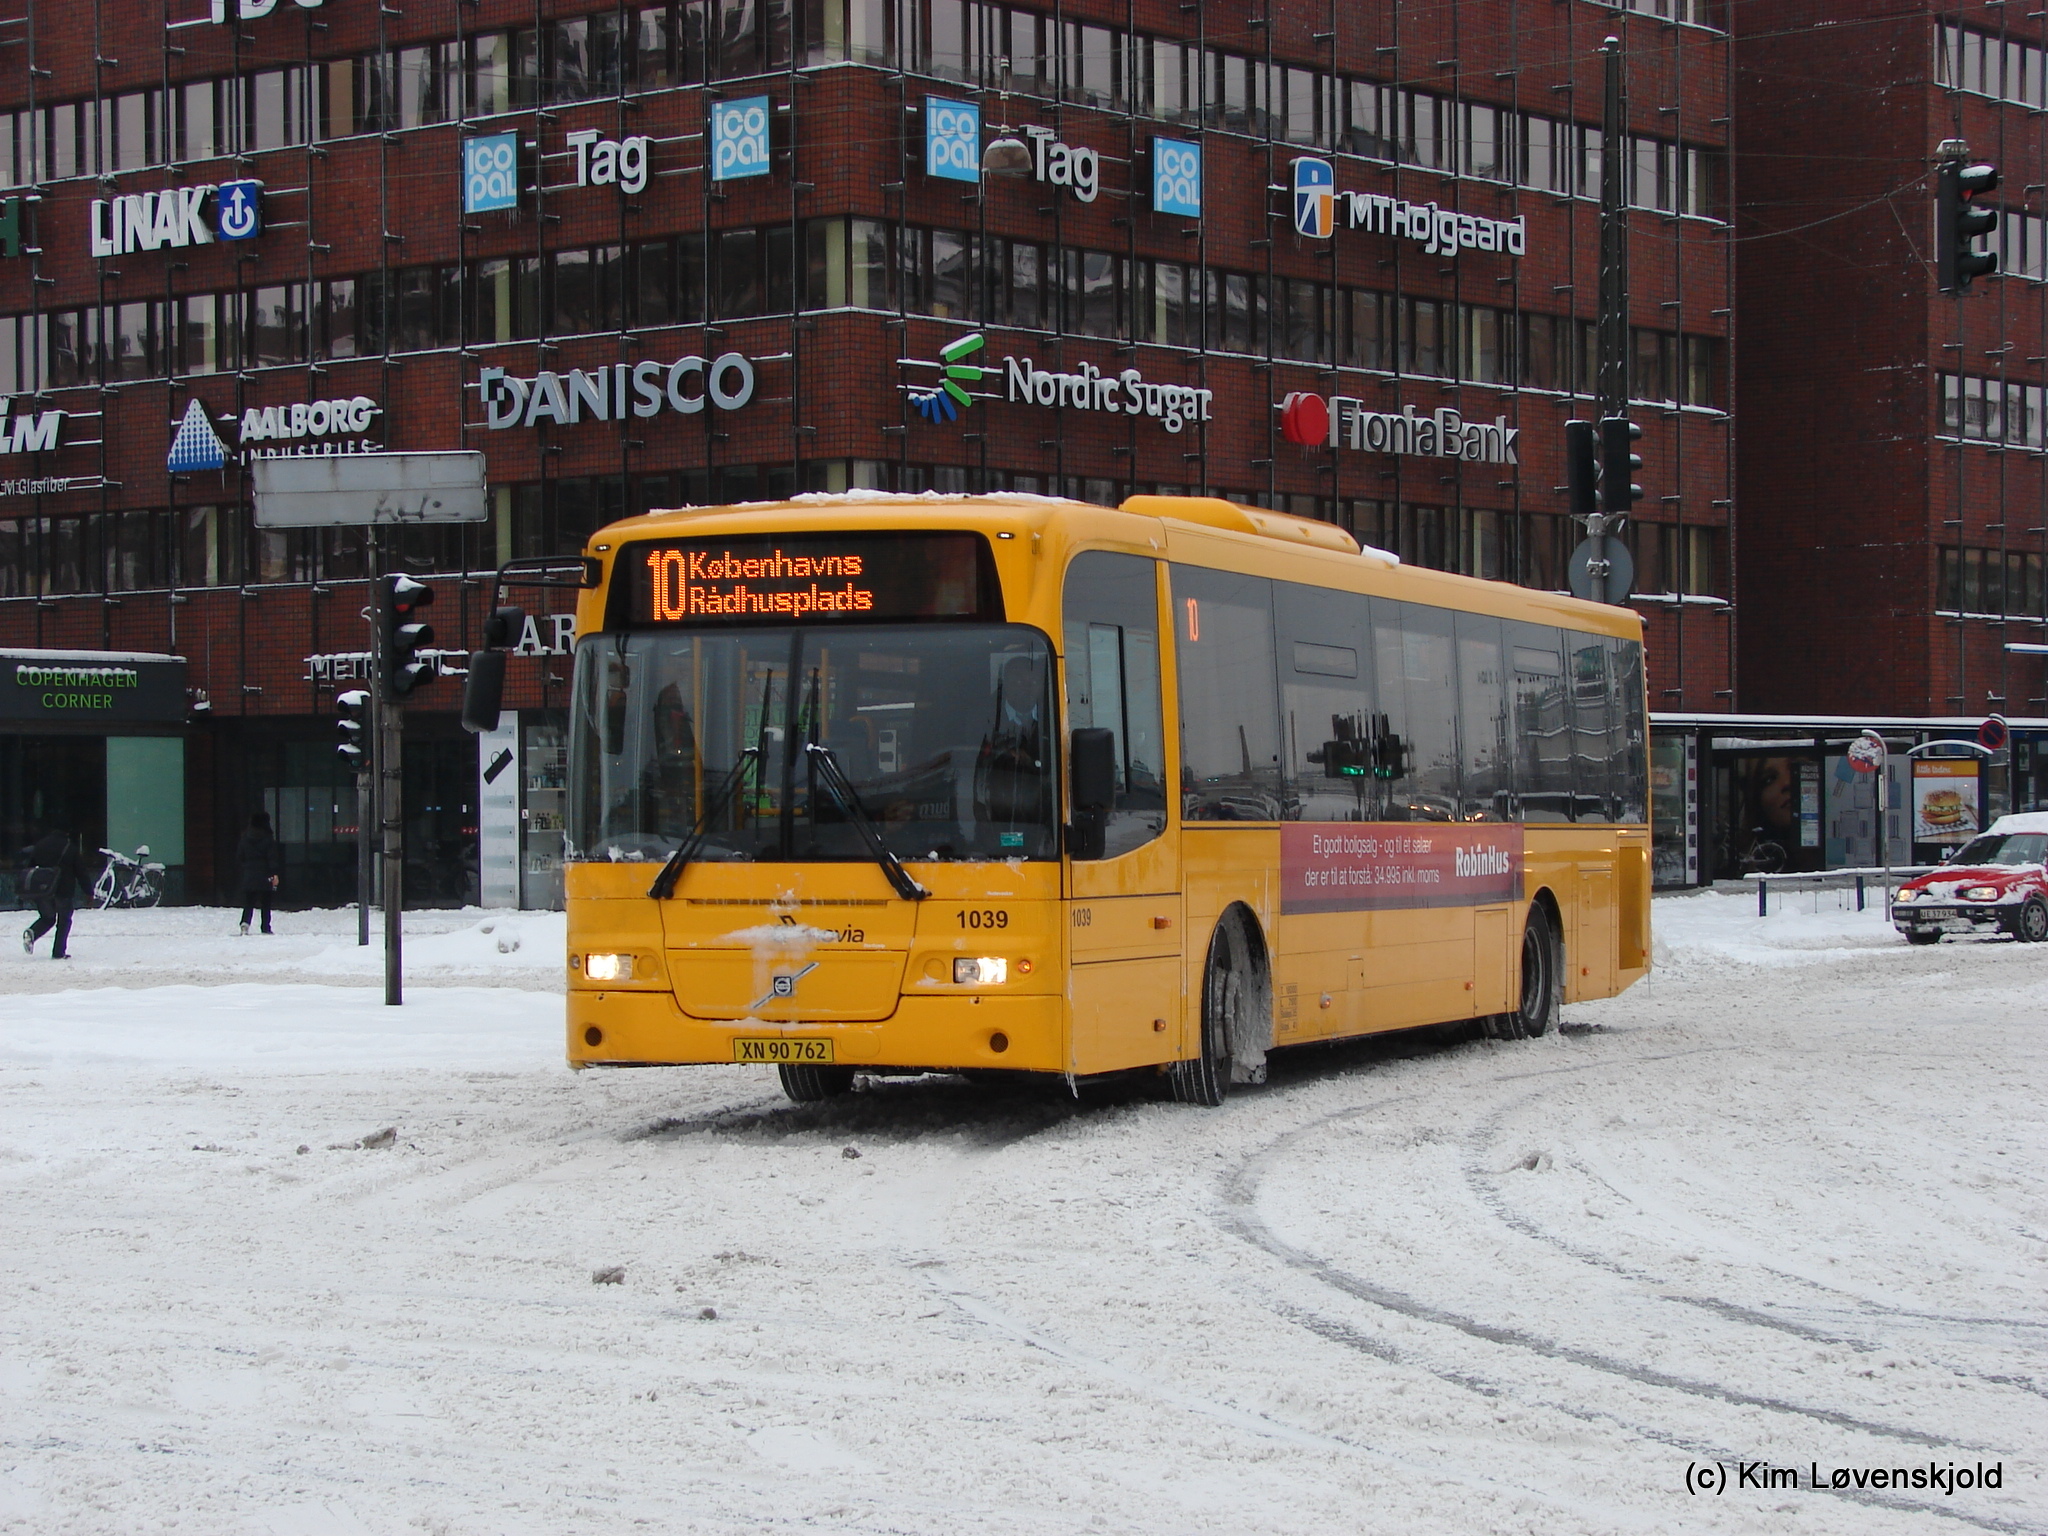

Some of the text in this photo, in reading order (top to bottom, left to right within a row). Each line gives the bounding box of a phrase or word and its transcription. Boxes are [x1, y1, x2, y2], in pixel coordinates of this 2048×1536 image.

[567, 130, 650, 194] Tag
[1024, 127, 1099, 203] Tag
[91, 185, 216, 258] LINAK
[480, 353, 755, 430] DANISCO
[240, 396, 377, 443] AALBORG
[689, 548, 863, 579] Københavns
[647, 549, 686, 621] 10
[690, 583, 873, 617] Rådhusplads
[1186, 597, 1199, 642] 10
[16, 668, 138, 689] COPENHAGEN
[42, 692, 113, 709] CORNER
[1313, 834, 1322, 855] Et
[1323, 834, 1343, 859] godt
[1343, 834, 1378, 858] boligsalg
[1384, 841, 1395, 858] og
[1403, 836, 1411, 853] et
[1412, 836, 1432, 853] salær
[1456, 843, 1509, 877] RobinHus
[1305, 867, 1319, 887] der
[1320, 871, 1329, 886] er
[1330, 866, 1338, 886] til
[1339, 868, 1347, 886] at
[1374, 866, 1401, 884] 34.995
[1417, 867, 1440, 883] moms
[956, 909, 1009, 930] 1039
[1072, 908, 1092, 927] 1039
[742, 1042, 826, 1059] XN 90 762
